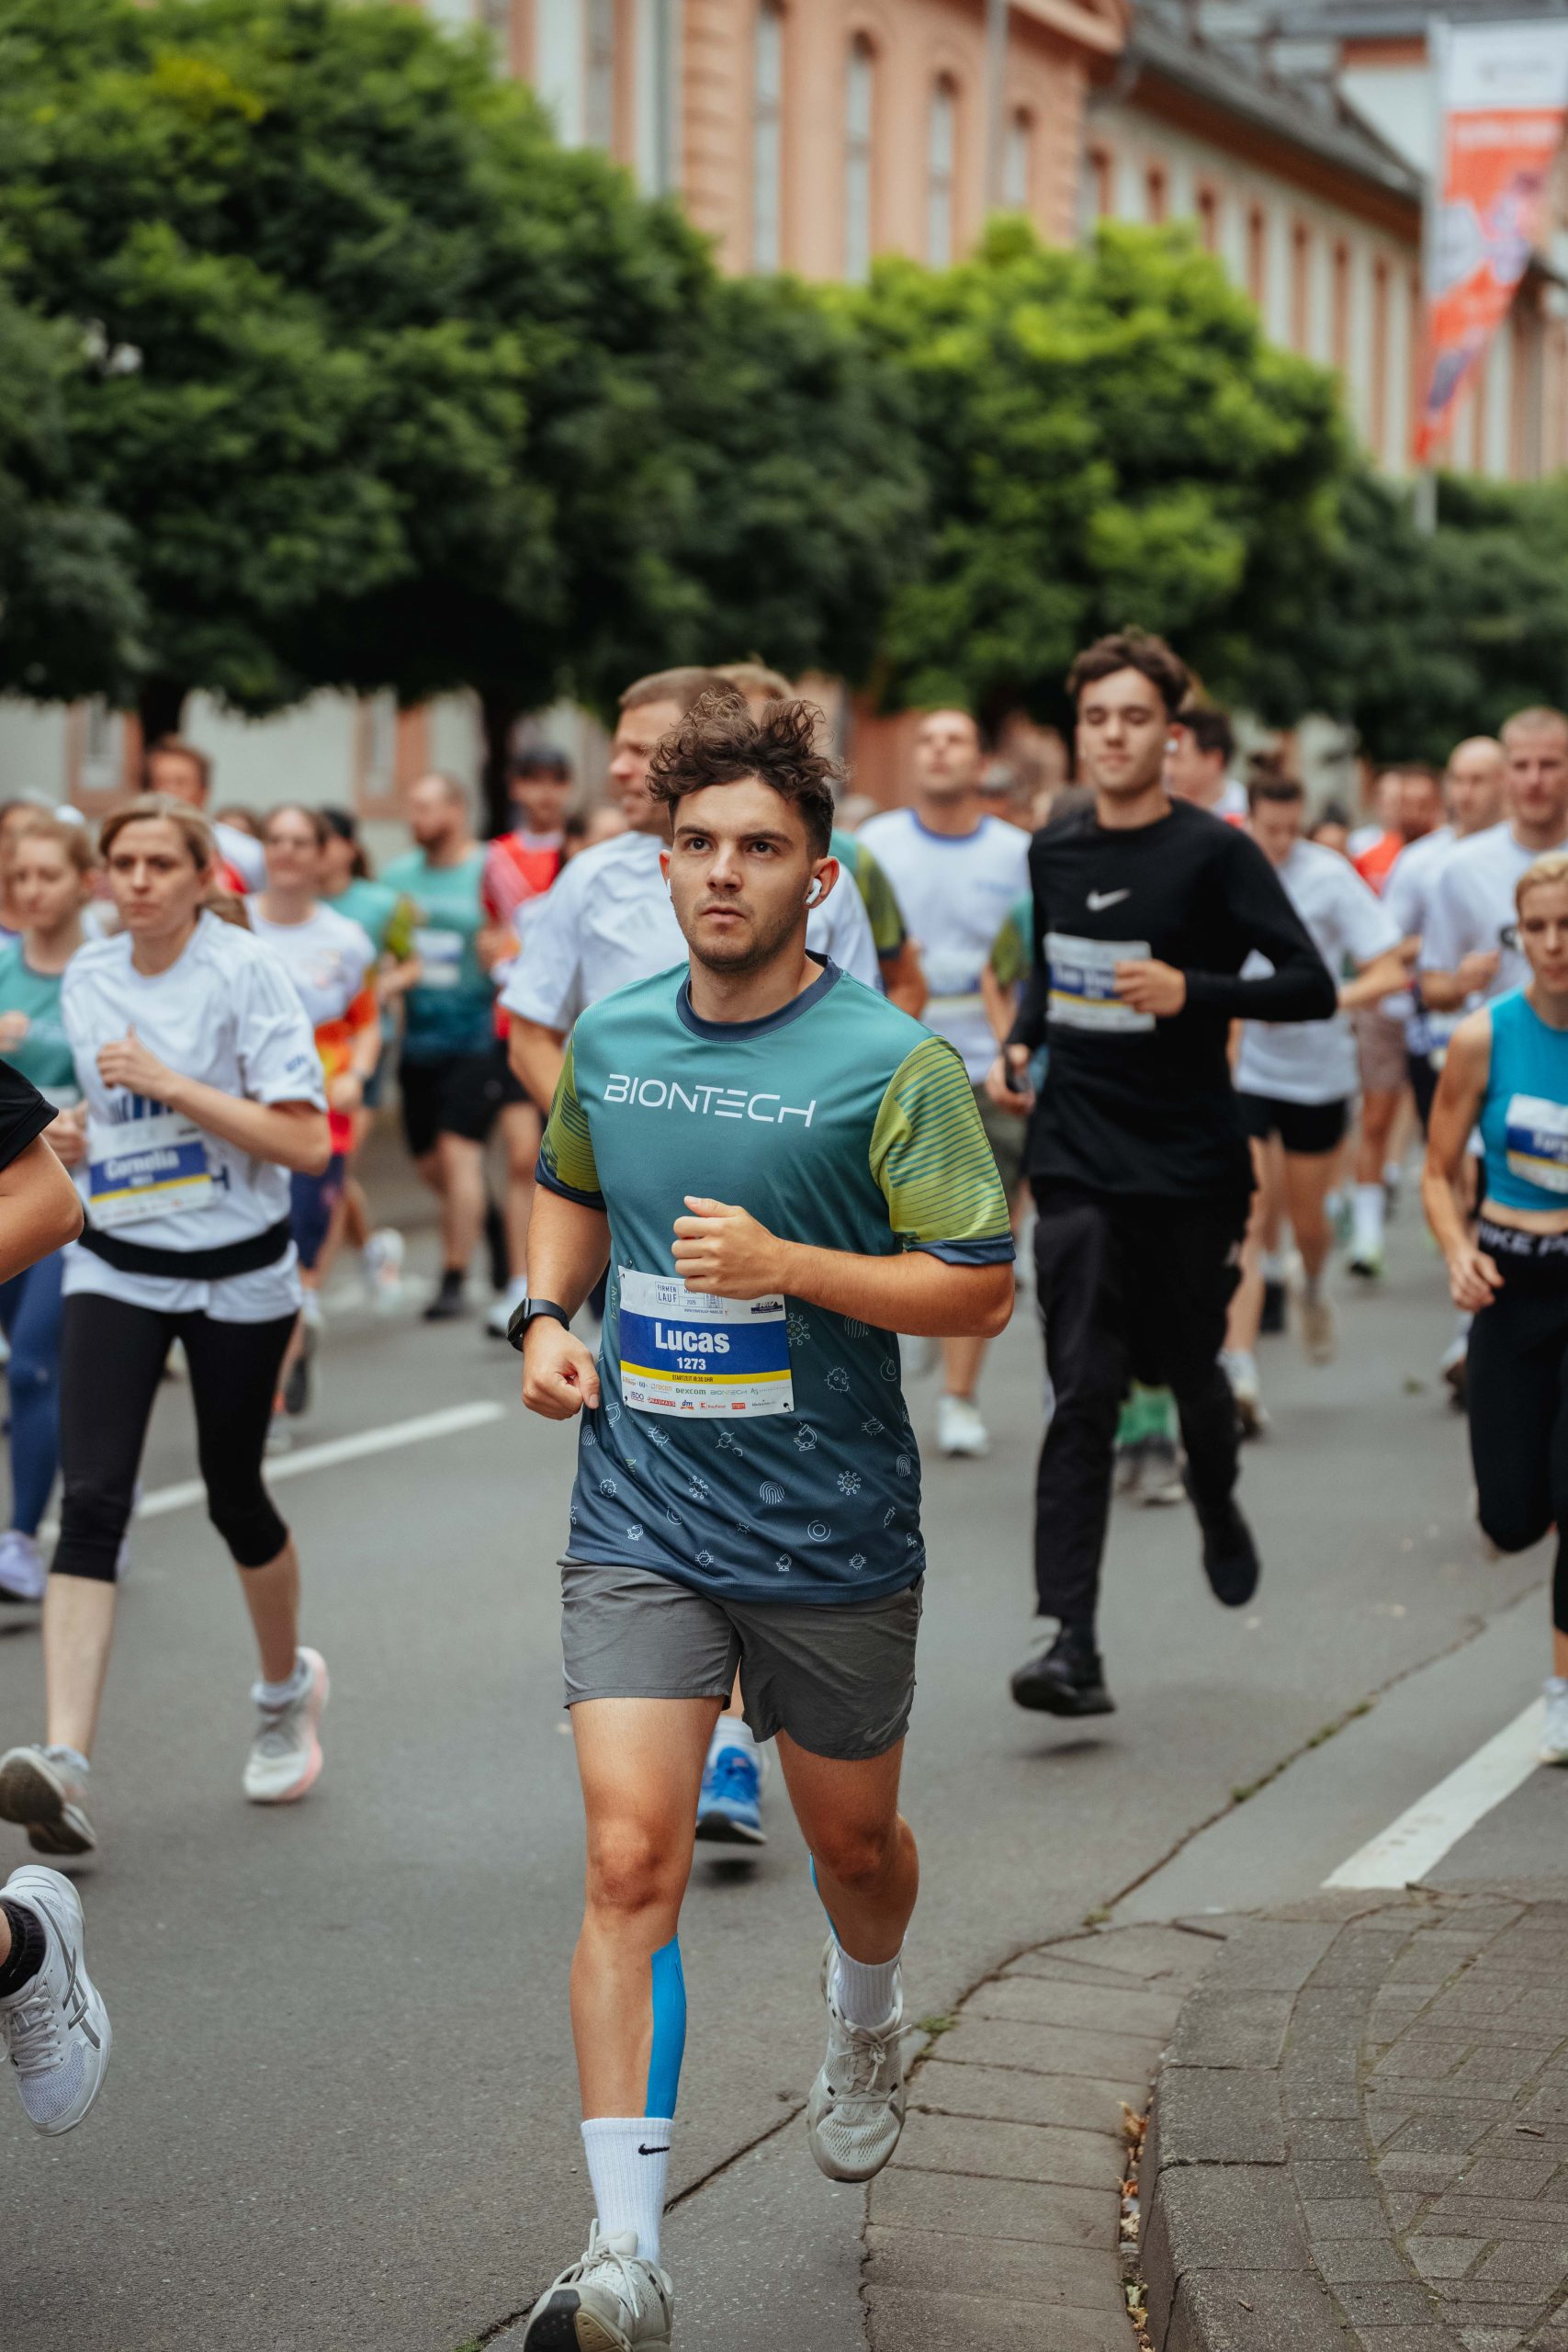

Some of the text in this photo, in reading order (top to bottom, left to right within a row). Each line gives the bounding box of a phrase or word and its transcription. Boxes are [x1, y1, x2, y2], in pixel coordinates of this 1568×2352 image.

[604, 1073, 817, 1128] BIONTECH
[104, 1148, 180, 1182] Cornelia
[657, 1284, 677, 1293] FIRMEN
[658, 1292, 677, 1303] LAUF
[655, 1322, 730, 1353] Lucas
[677, 1357, 706, 1371] 1273
[631, 1391, 645, 1400] BDO
